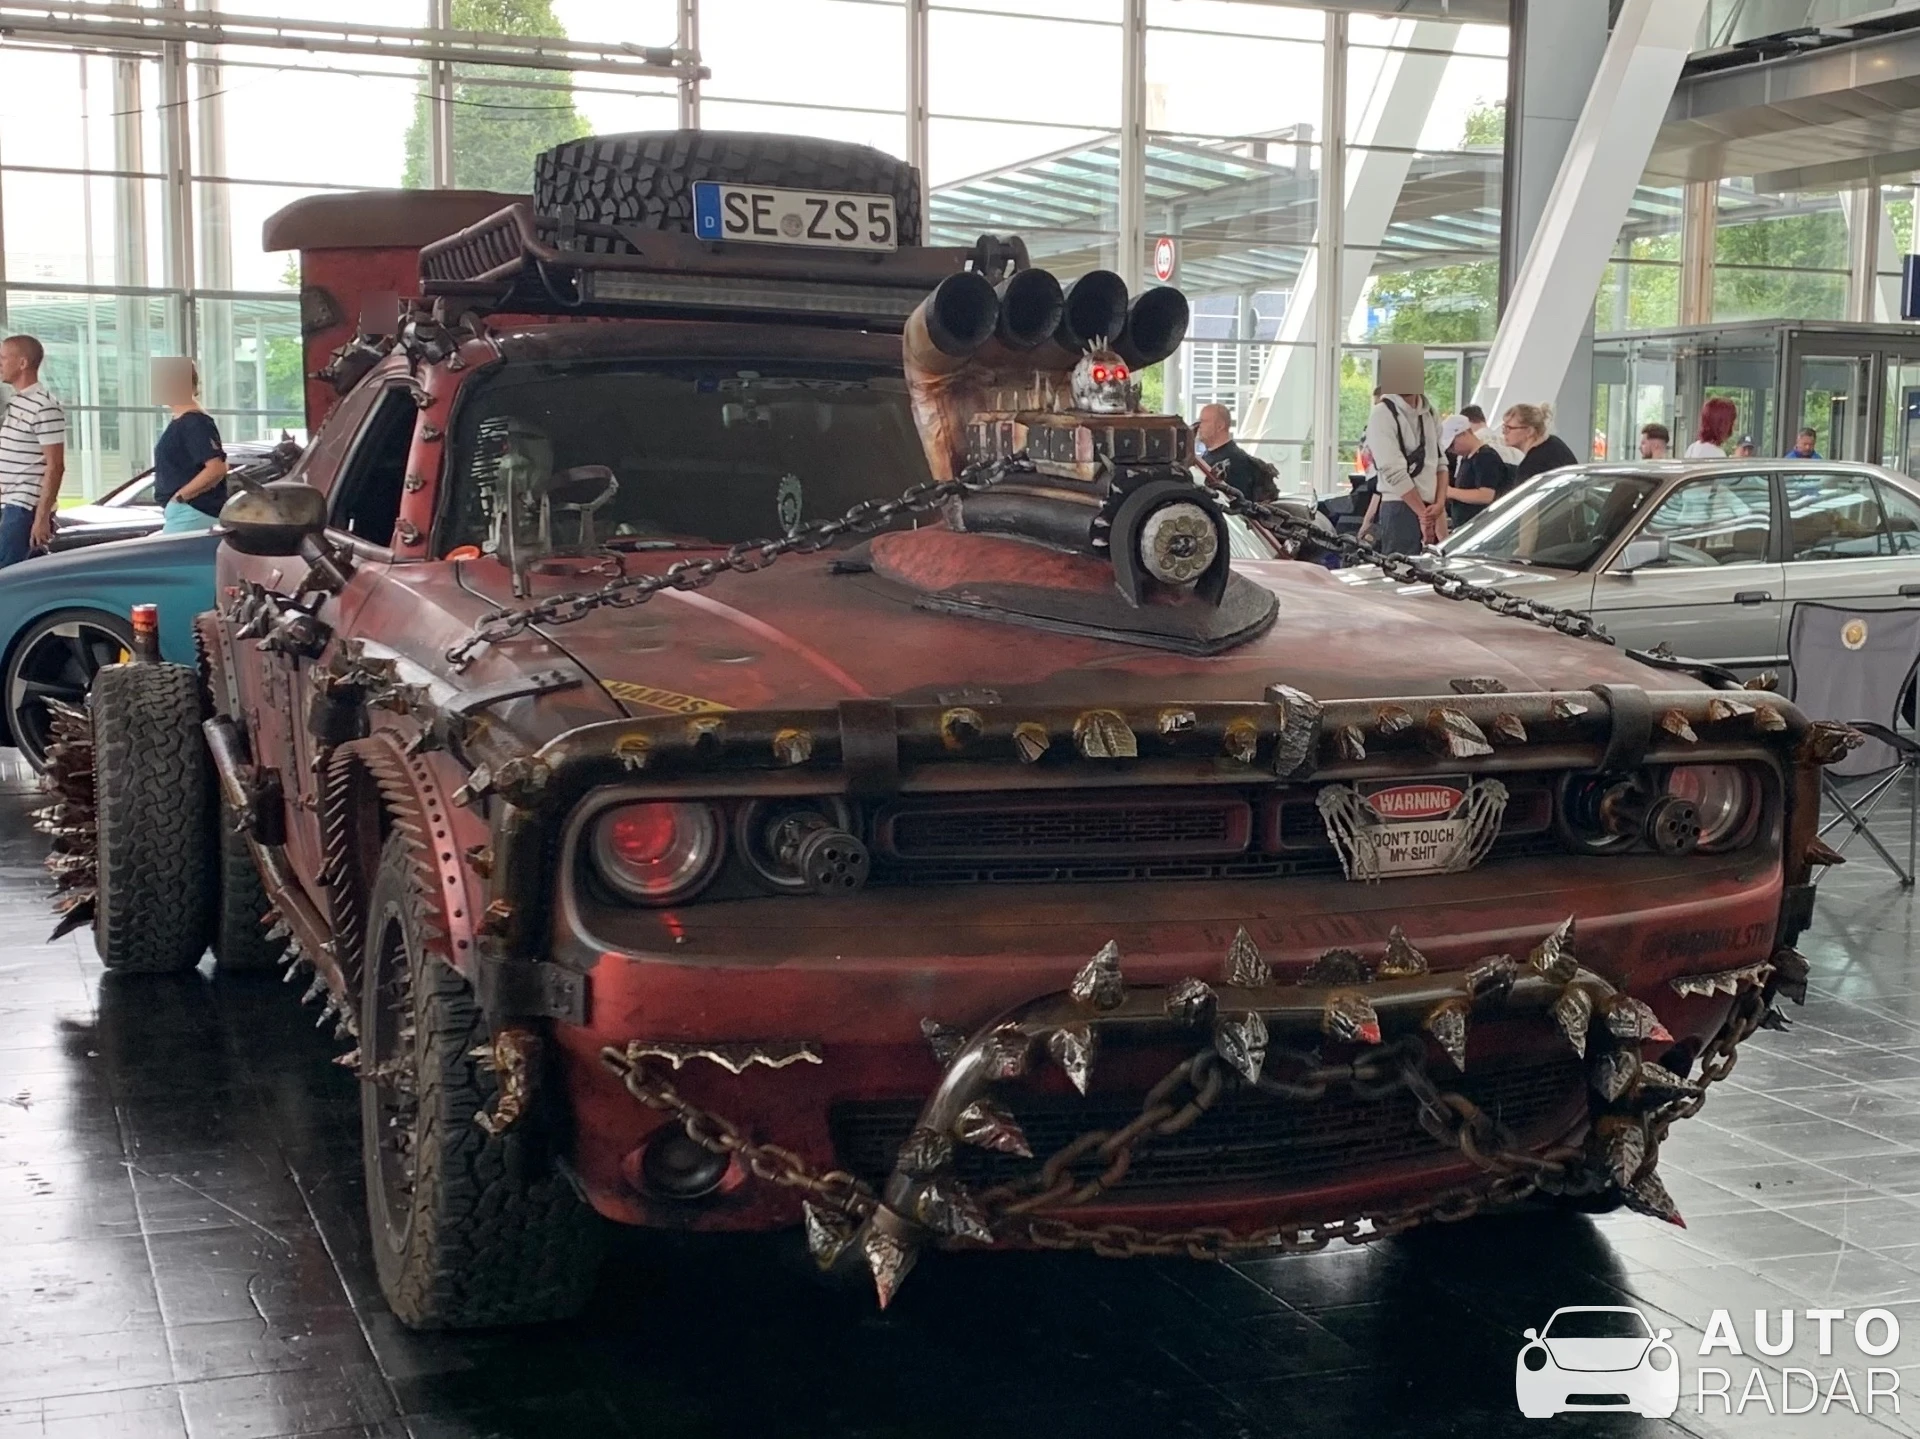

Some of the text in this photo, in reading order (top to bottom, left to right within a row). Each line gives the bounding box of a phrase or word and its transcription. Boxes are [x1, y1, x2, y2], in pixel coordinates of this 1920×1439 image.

[704, 216, 715, 229] D
[724, 191, 891, 243] SE ZS 5
[608, 683, 708, 712] HANDS
[1378, 791, 1451, 812] WARNING
[1373, 828, 1454, 848] DON'T TOUCH
[1390, 845, 1438, 862] MY SHIT
